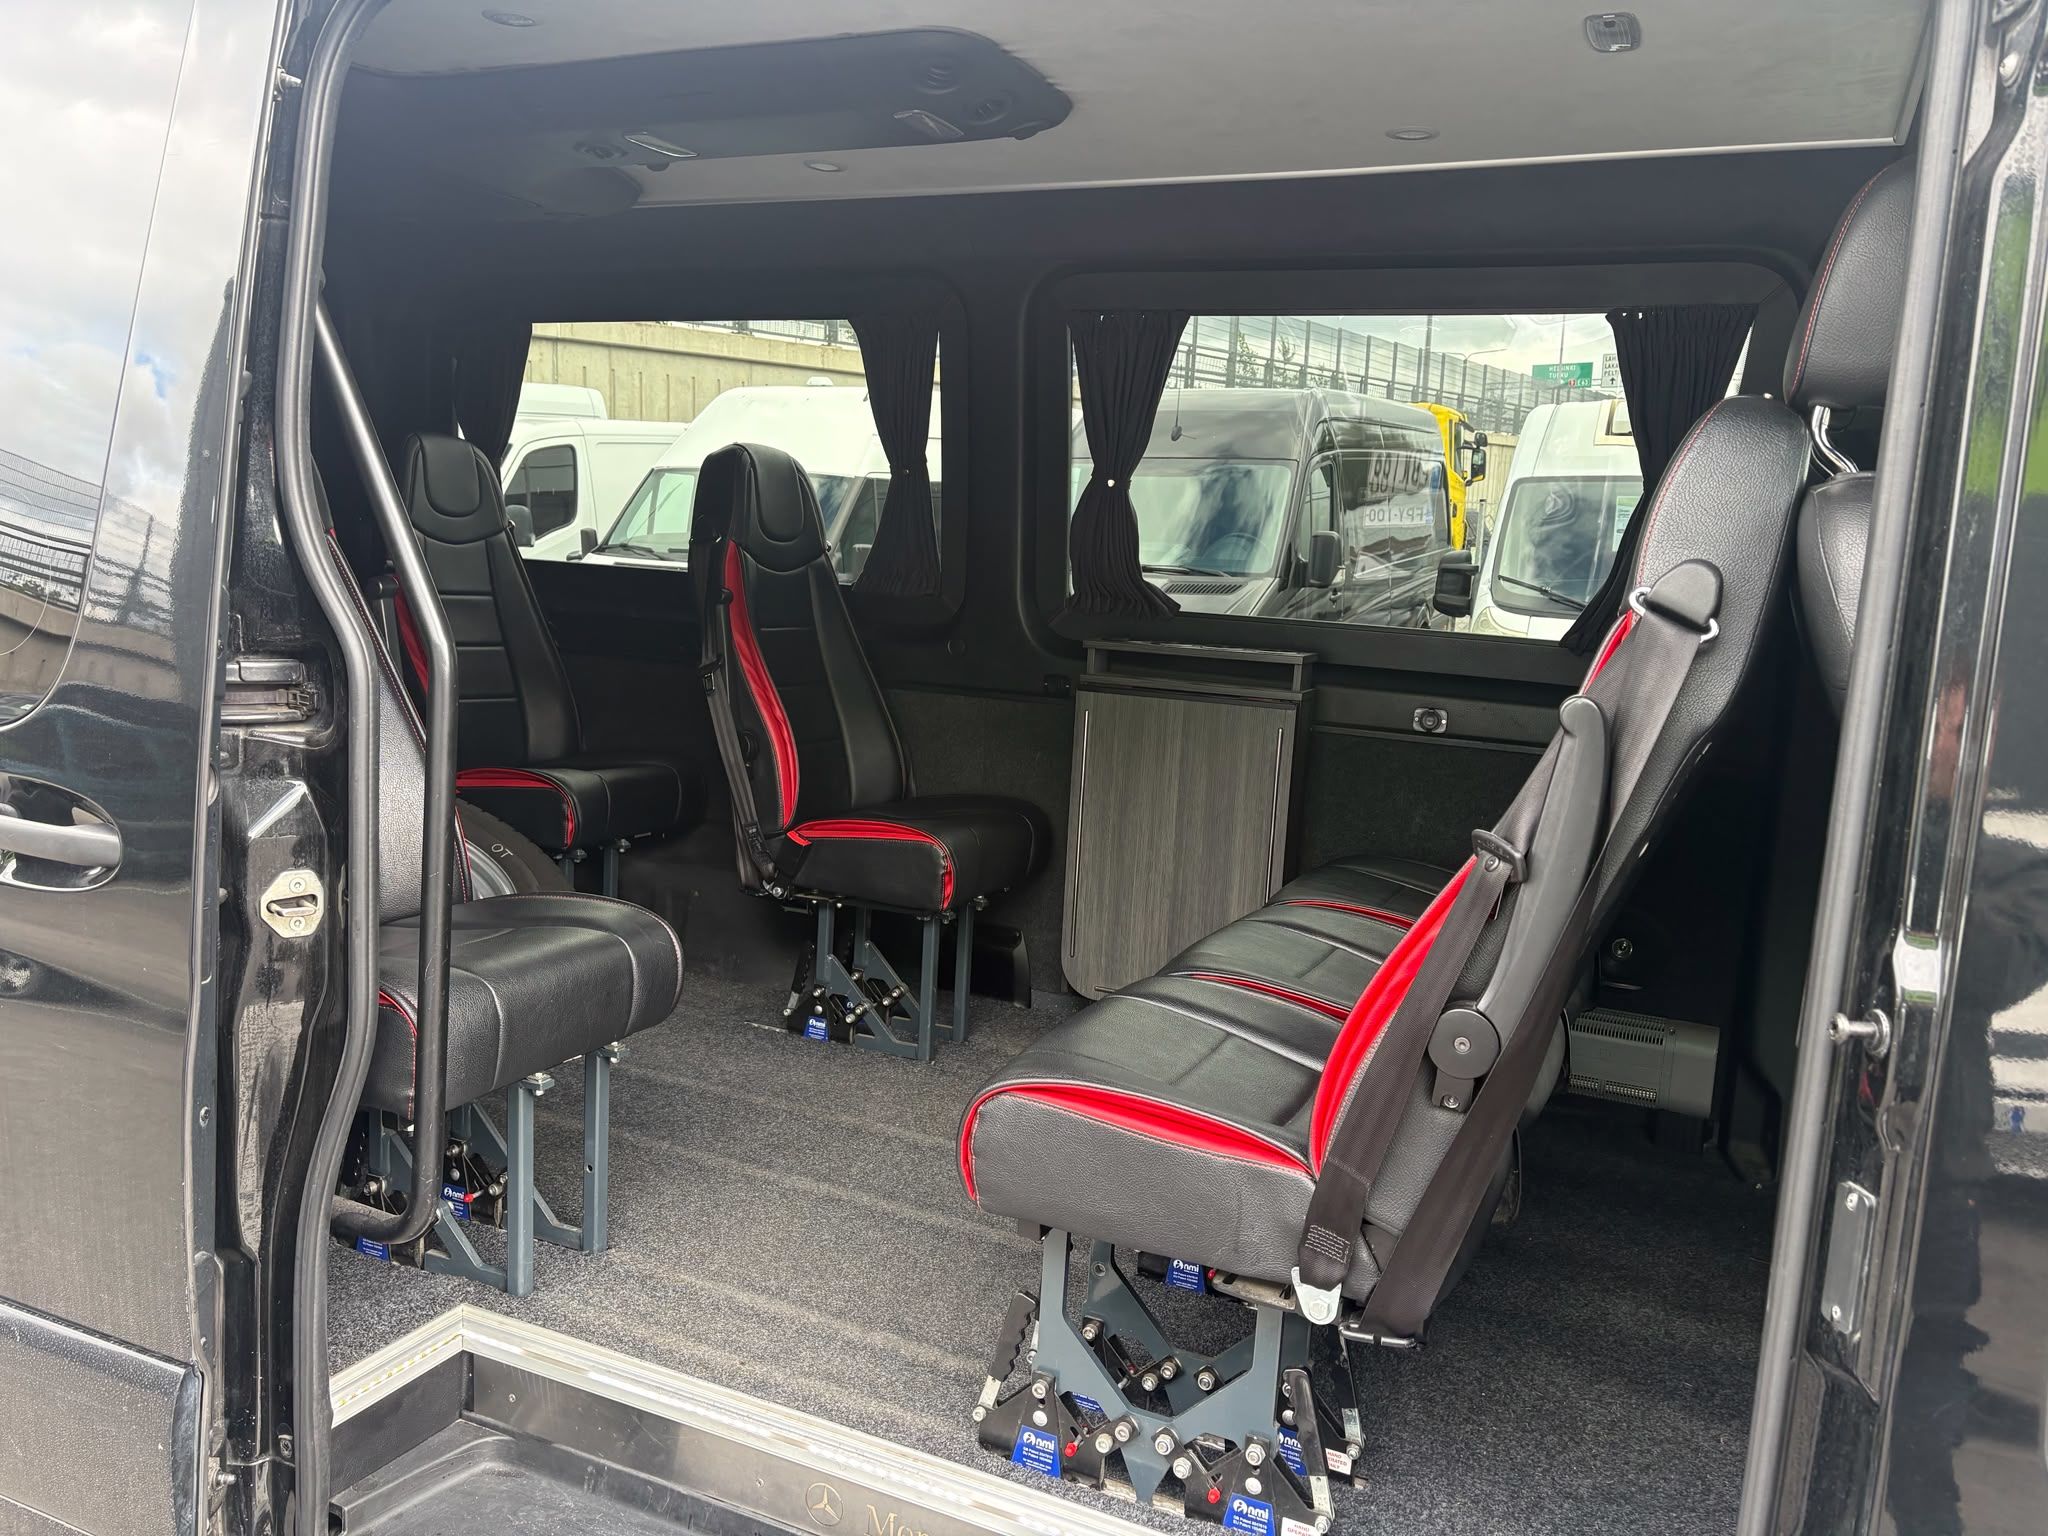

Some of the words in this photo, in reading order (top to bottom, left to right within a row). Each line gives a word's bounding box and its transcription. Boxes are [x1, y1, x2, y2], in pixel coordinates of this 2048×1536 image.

[1183, 1263, 1200, 1273] nmi
[1036, 1438, 1055, 1451] nmi
[1248, 1506, 1269, 1520] nmi
